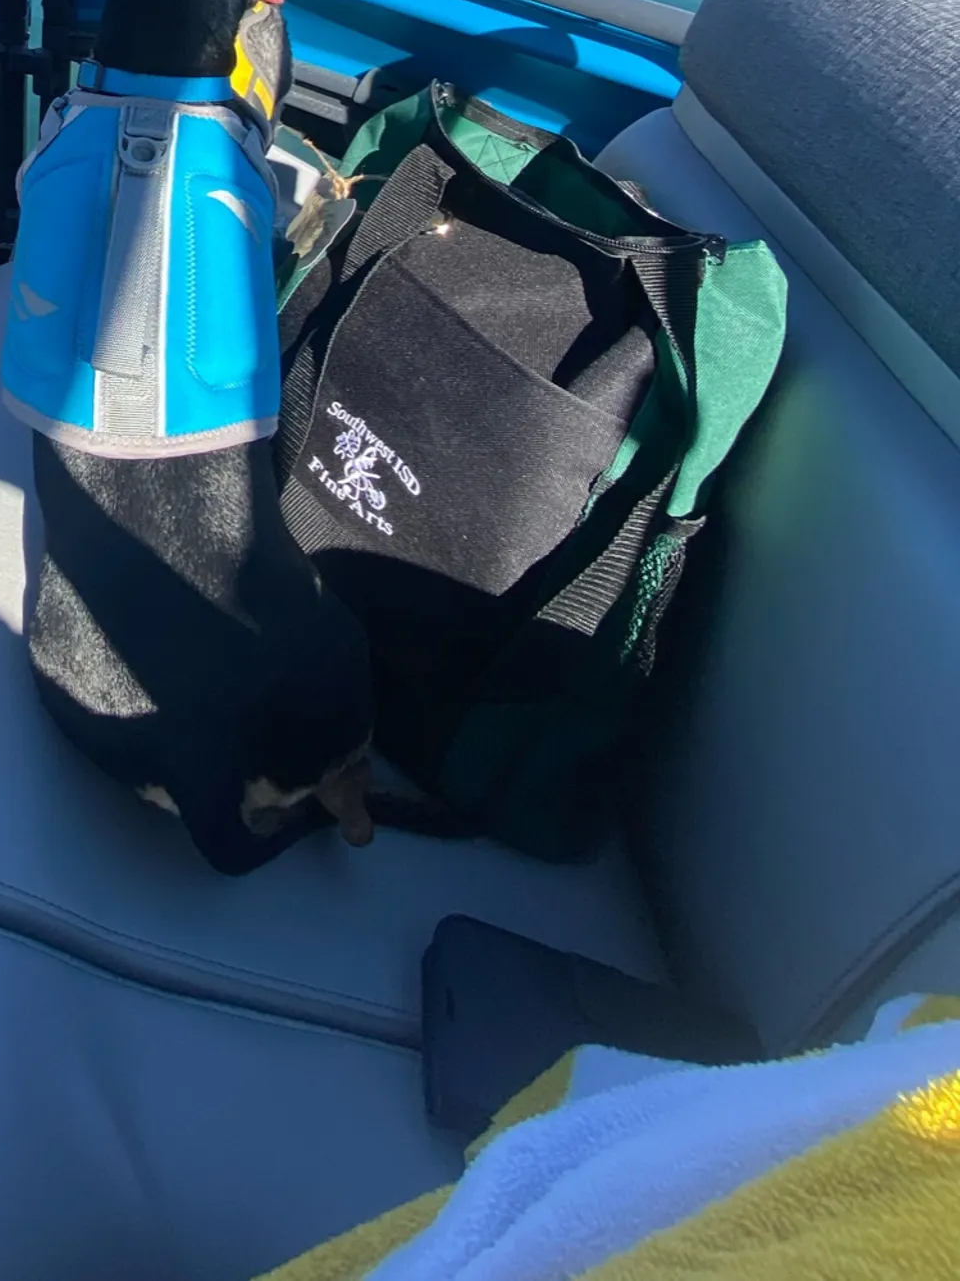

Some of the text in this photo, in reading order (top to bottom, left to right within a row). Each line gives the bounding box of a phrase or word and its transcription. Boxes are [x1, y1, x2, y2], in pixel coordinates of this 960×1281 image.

[326, 401, 421, 496] Southwest ISD
[307, 455, 394, 536] Fine Arts
